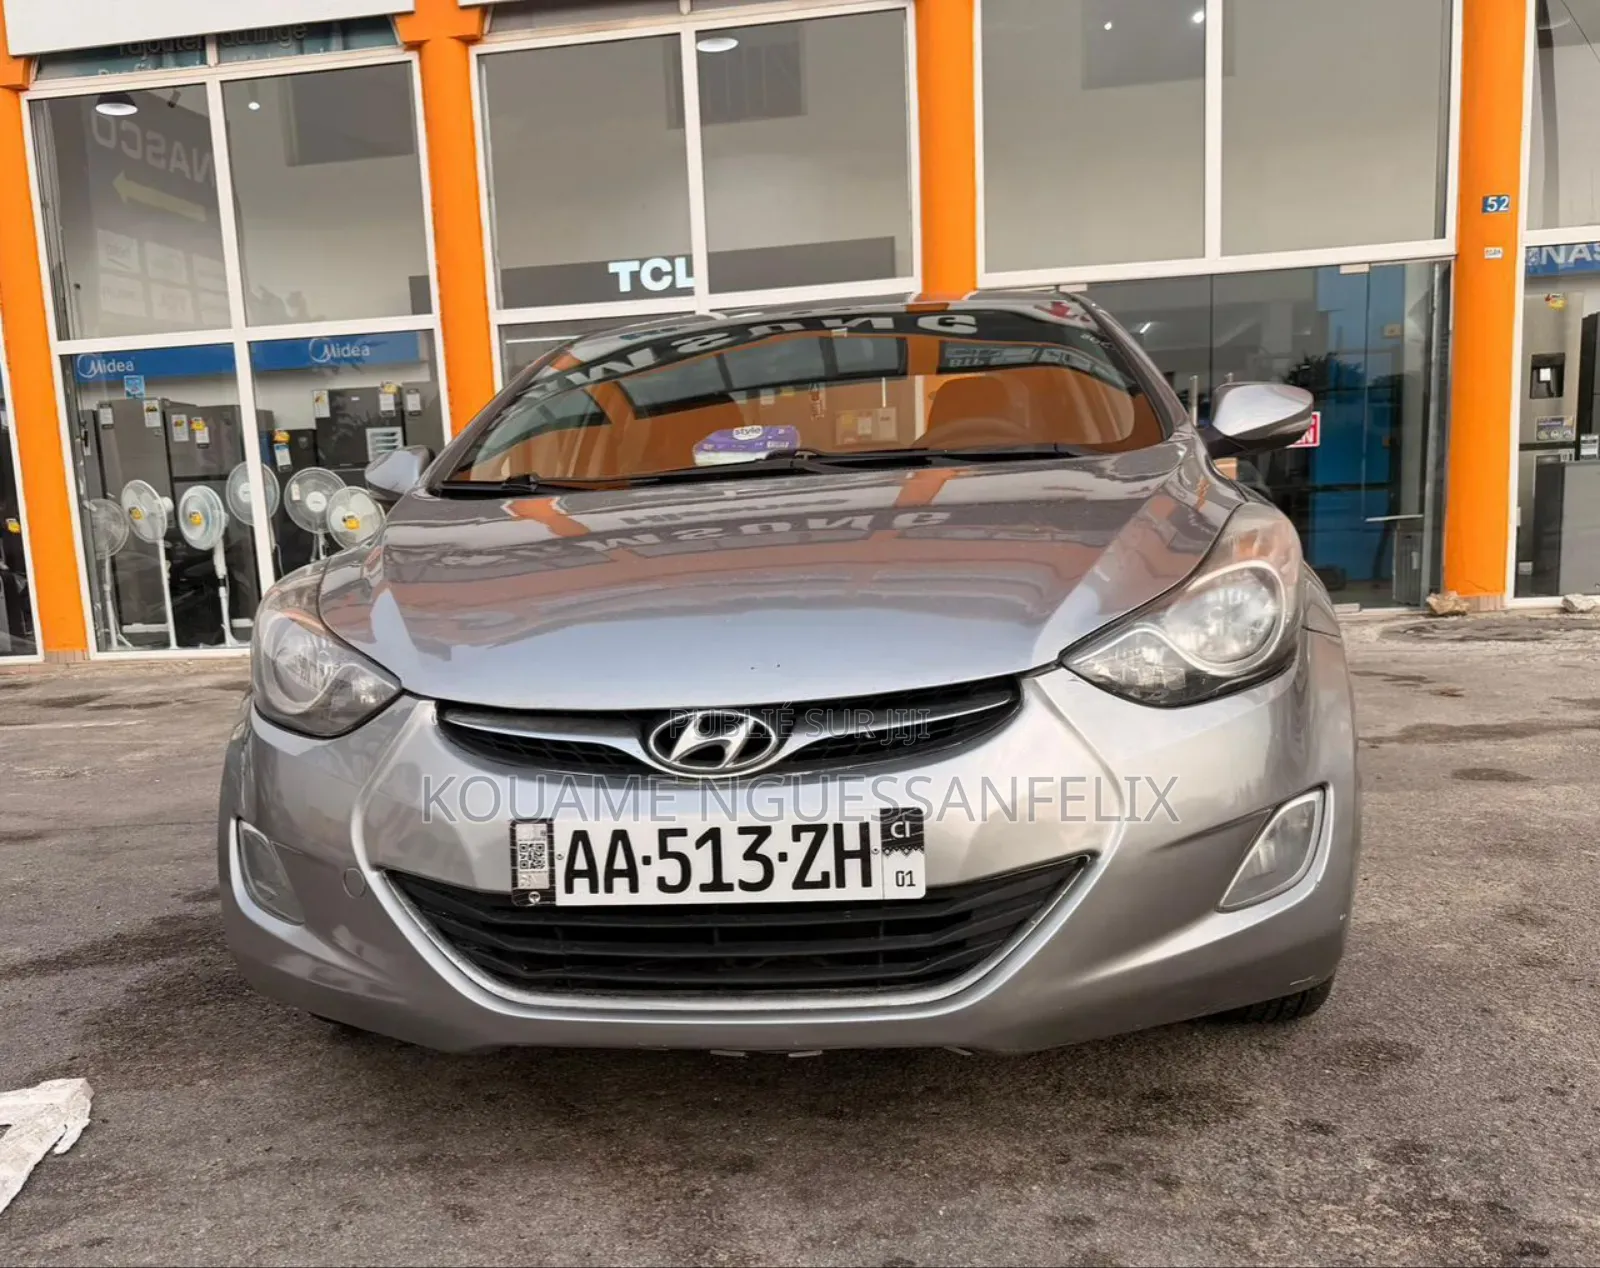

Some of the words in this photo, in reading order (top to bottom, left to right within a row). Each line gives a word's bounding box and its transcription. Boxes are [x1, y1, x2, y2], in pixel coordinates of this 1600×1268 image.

[1486, 195, 1509, 212] 52
[608, 256, 695, 293] TCL
[309, 337, 371, 363] Midea
[77, 353, 135, 378] Midea
[734, 426, 762, 436] style
[891, 820, 910, 838] CI
[895, 870, 916, 887] 01
